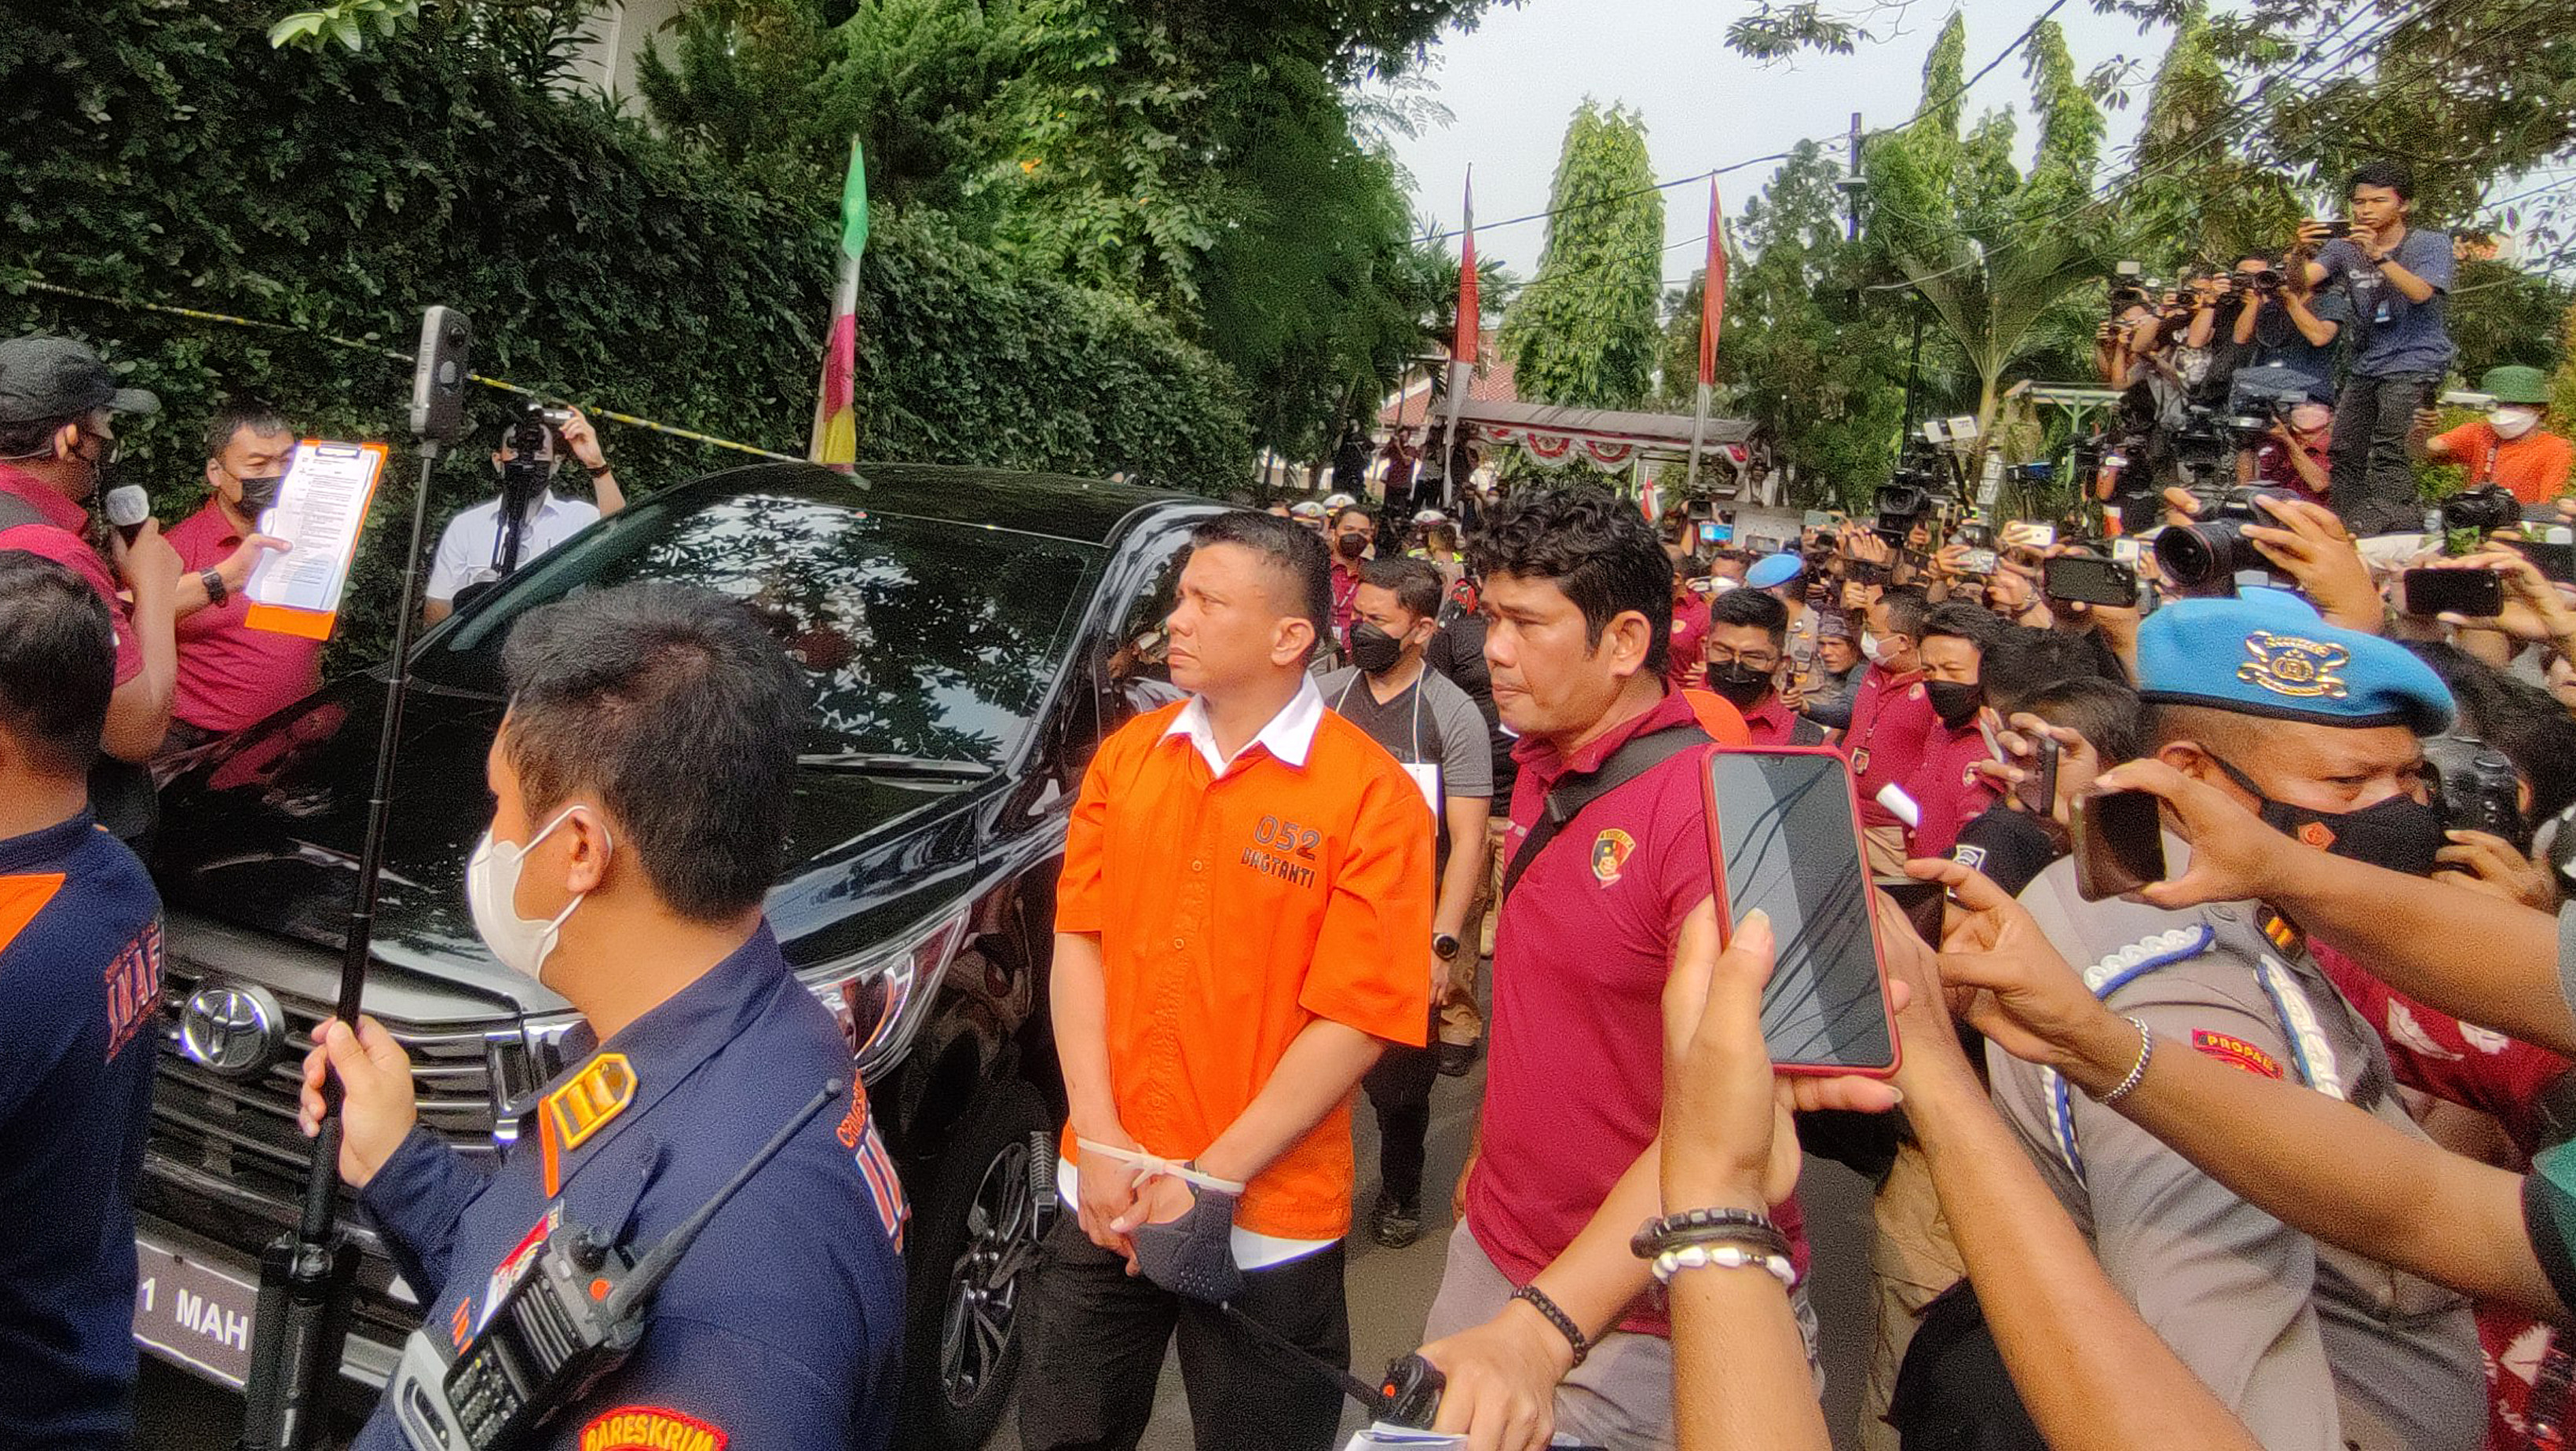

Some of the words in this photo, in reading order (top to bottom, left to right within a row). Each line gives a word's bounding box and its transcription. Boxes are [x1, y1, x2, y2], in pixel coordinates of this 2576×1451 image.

[1255, 815, 1320, 861] 052
[142, 1277, 156, 1312] 1
[176, 1288, 249, 1351] MAH
[586, 1414, 716, 1451] BARESKRIM
